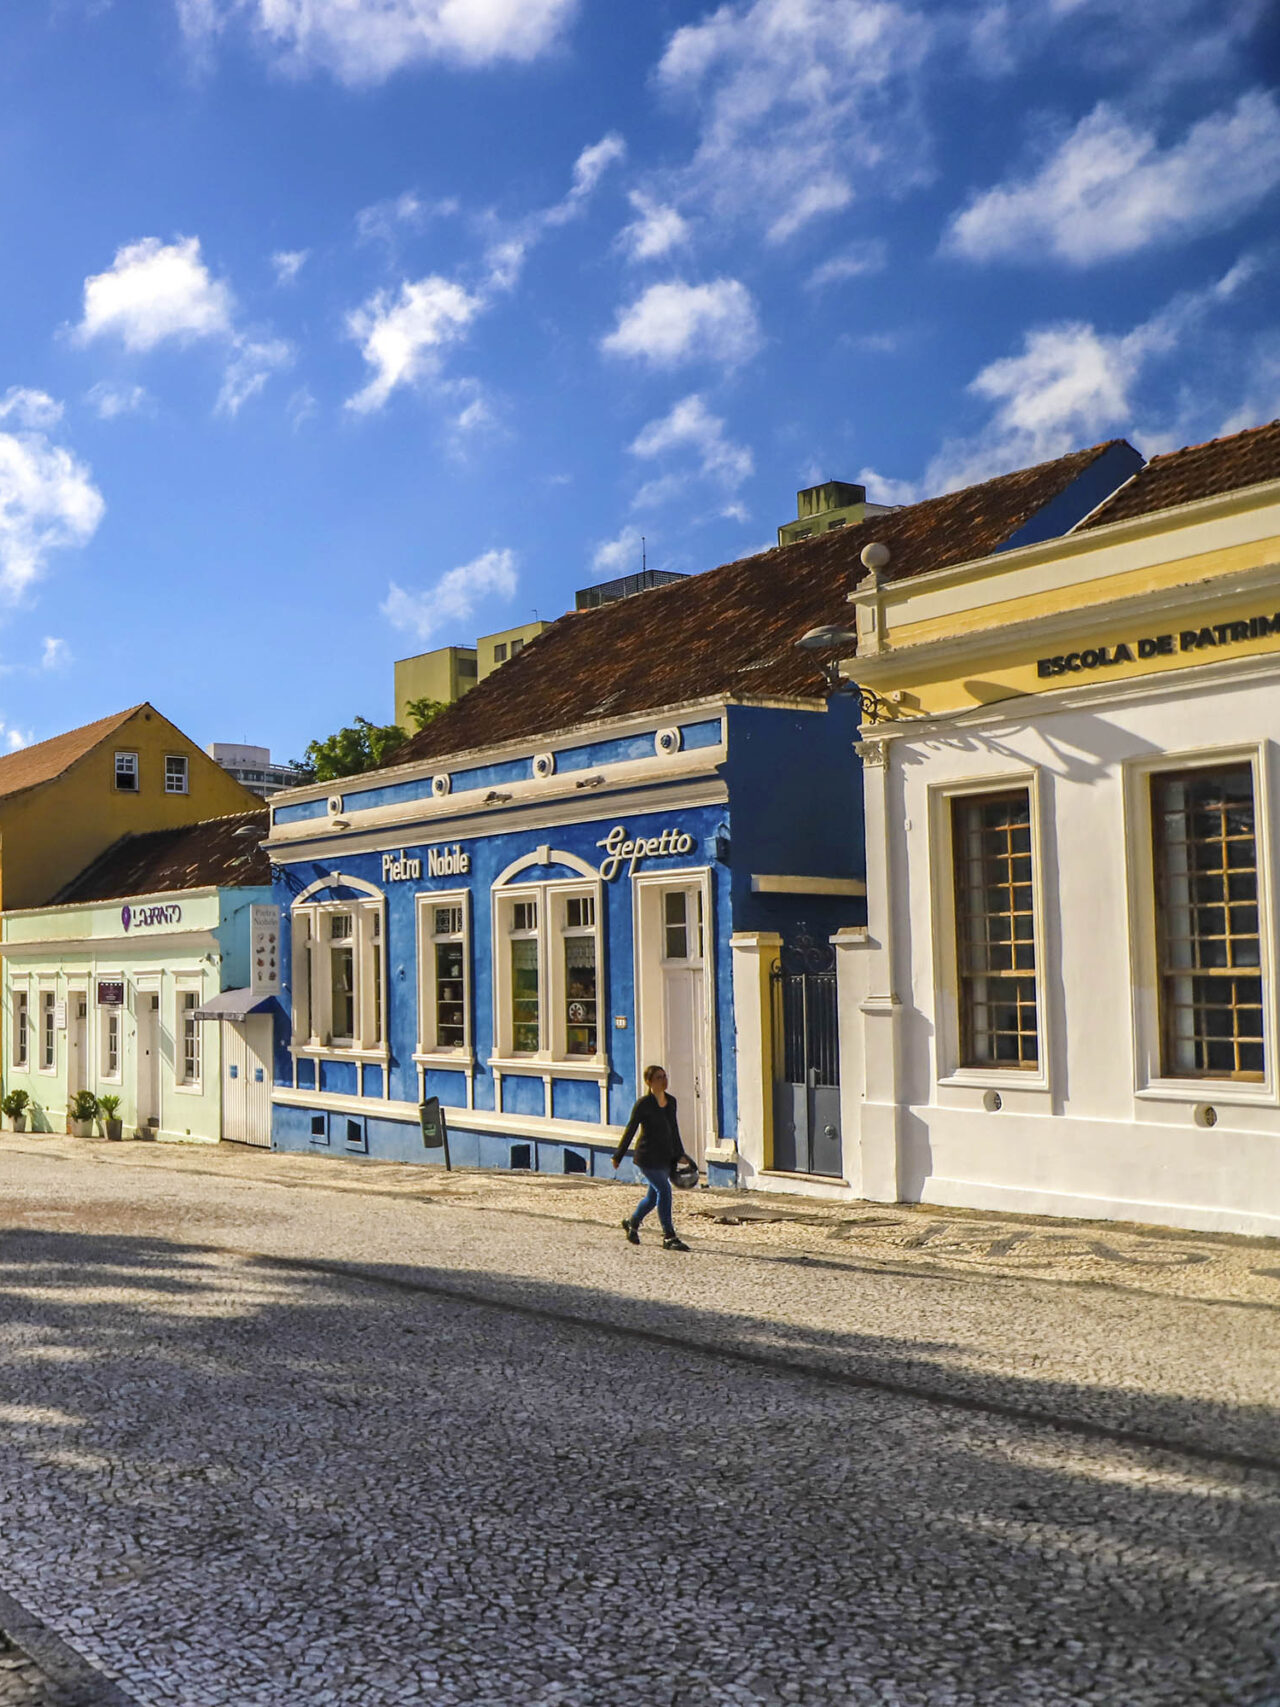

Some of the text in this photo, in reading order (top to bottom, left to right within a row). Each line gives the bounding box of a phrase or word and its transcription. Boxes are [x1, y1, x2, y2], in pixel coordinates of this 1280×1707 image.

[1037, 643, 1134, 678] ESCOLA
[1138, 634, 1173, 659] DE
[382, 844, 470, 882] Pietra Nobile
[595, 825, 693, 881] Gepetto
